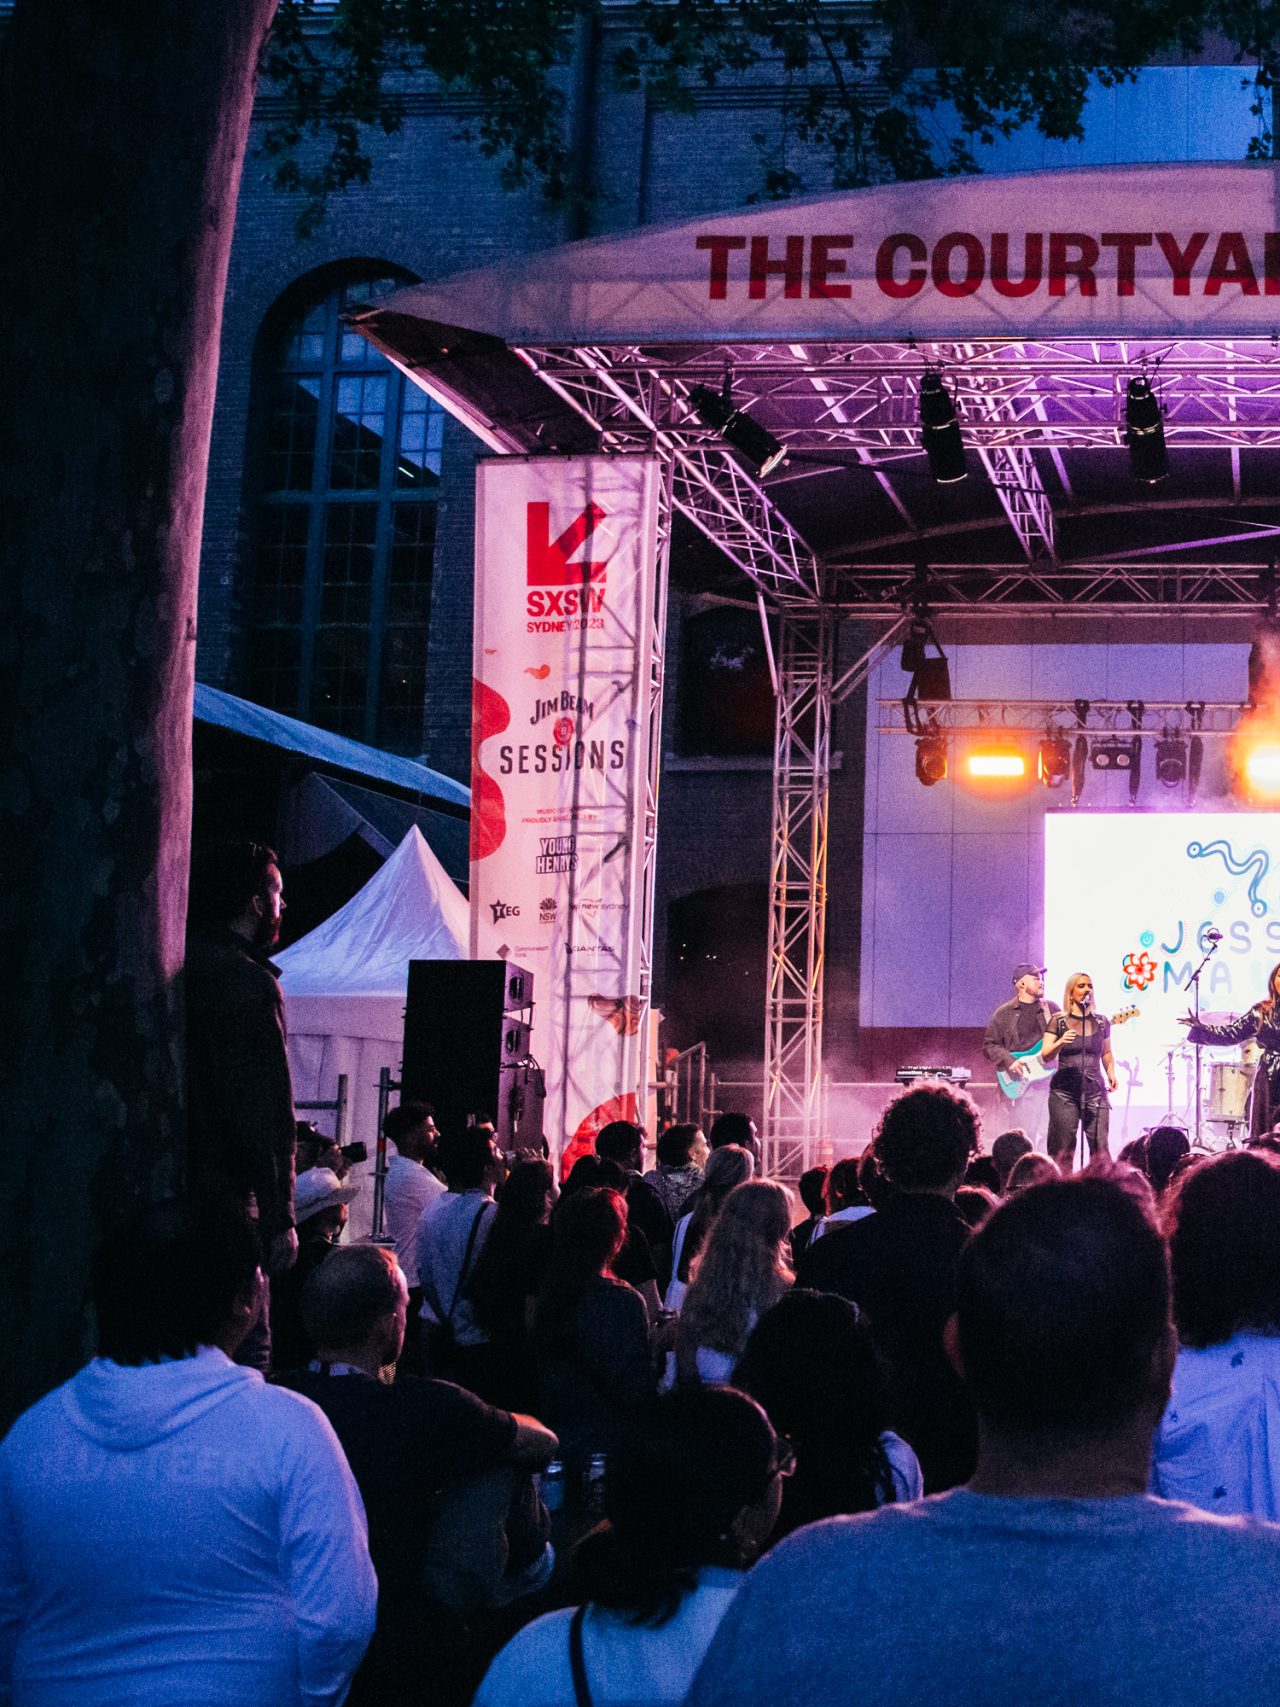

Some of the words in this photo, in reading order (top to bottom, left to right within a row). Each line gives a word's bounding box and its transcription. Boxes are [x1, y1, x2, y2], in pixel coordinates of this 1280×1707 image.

[696, 234, 854, 300] THE
[527, 588, 606, 617] SXSW
[527, 619, 573, 633] SYDNEY
[574, 618, 604, 631] 2023
[530, 698, 558, 725] JIM
[560, 690, 594, 720] BEAM
[500, 740, 624, 774] SESSIONS
[539, 835, 577, 856] YOUNG
[536, 853, 579, 874] HENRYS
[539, 912, 557, 920] NSW
